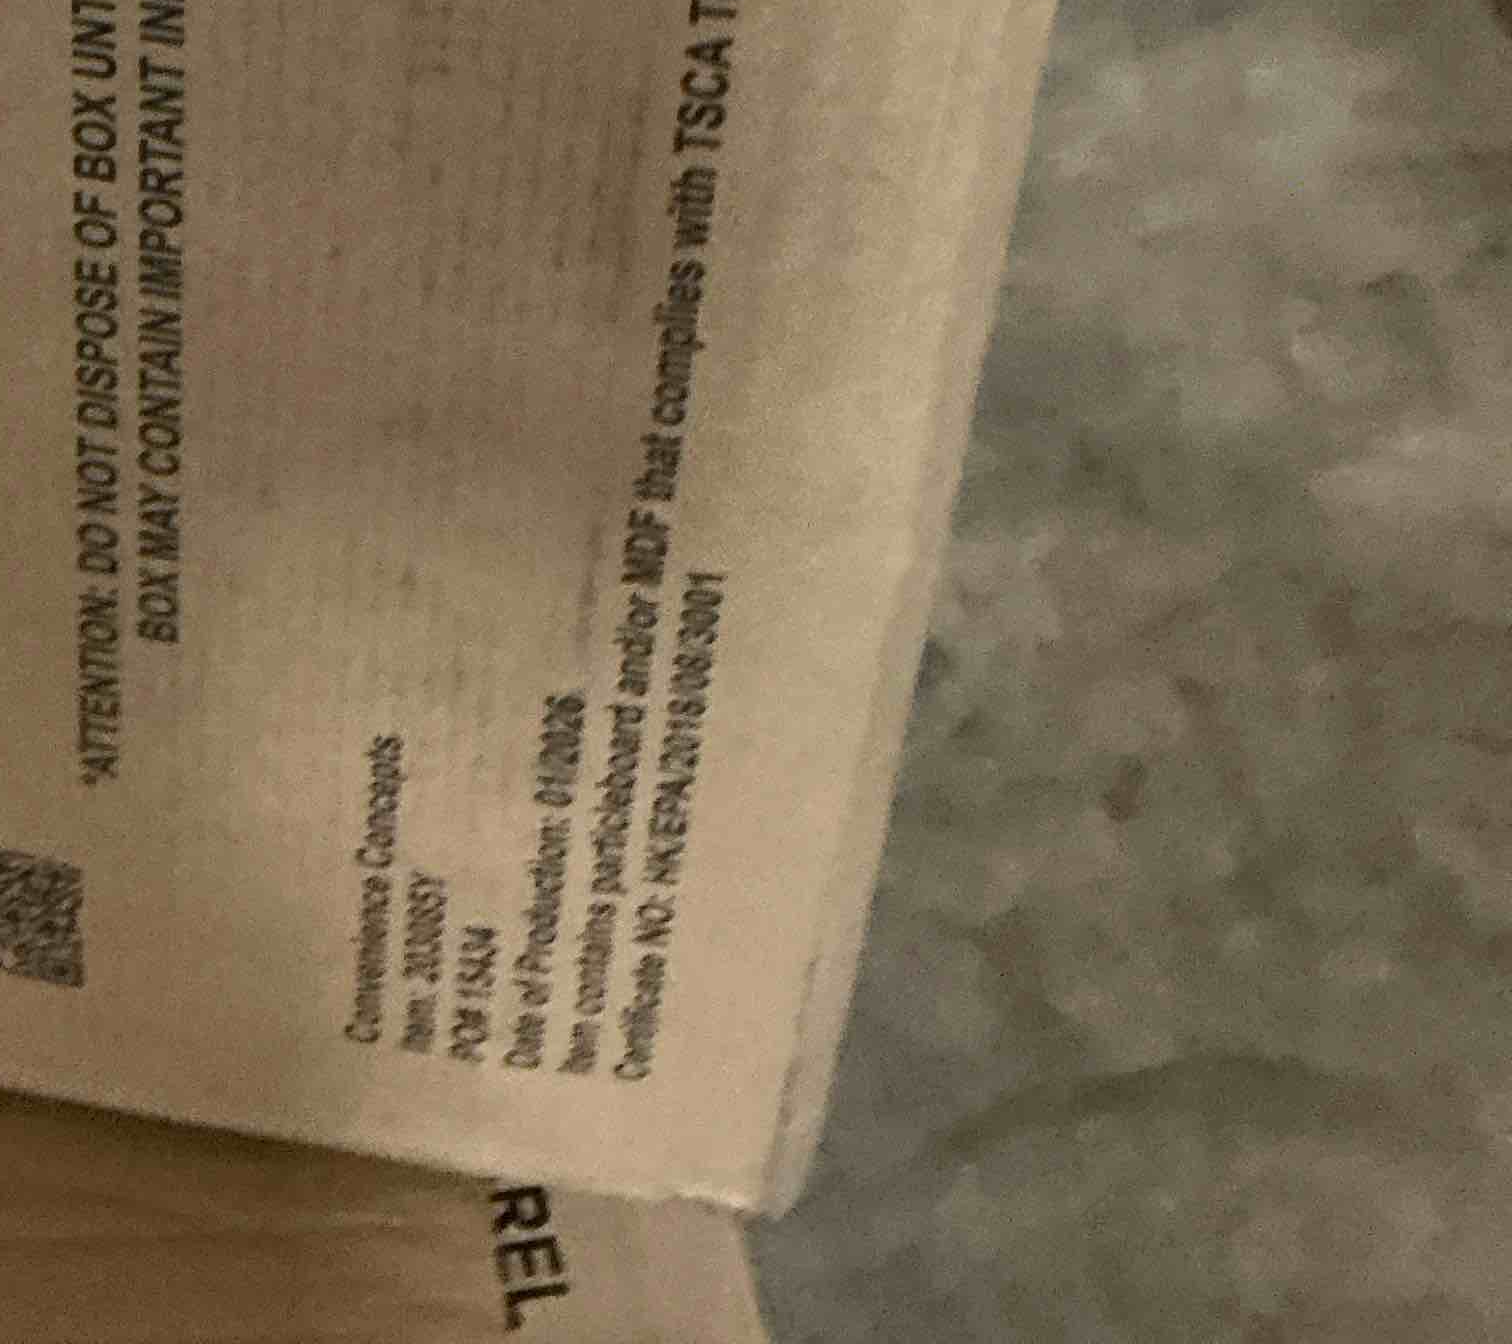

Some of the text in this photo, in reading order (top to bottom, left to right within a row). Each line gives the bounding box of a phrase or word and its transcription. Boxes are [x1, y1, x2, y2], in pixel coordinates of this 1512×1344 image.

[72, 91, 119, 182] BOX
[672, 37, 734, 153] TSCA
[73, 189, 120, 245] OF
[137, 55, 185, 301] IMPORTANT
[667, 164, 717, 247] with
[74, 256, 121, 428] DISPOSE
[651, 258, 705, 425] complies
[137, 310, 183, 476] CONTAIN
[75, 436, 121, 514] NOT
[631, 433, 681, 501] that
[75, 522, 121, 573] DO
[137, 485, 181, 561] MAY
[620, 508, 669, 585] MDF
[137, 567, 181, 643] BOX
[614, 591, 659, 695] and/or
[590, 703, 643, 894] particleboard
[345, 734, 406, 1043] Convenience Concepts
[513, 977, 552, 1005] of
[574, 902, 617, 1015] contains
[502, 1013, 547, 1069] Date
